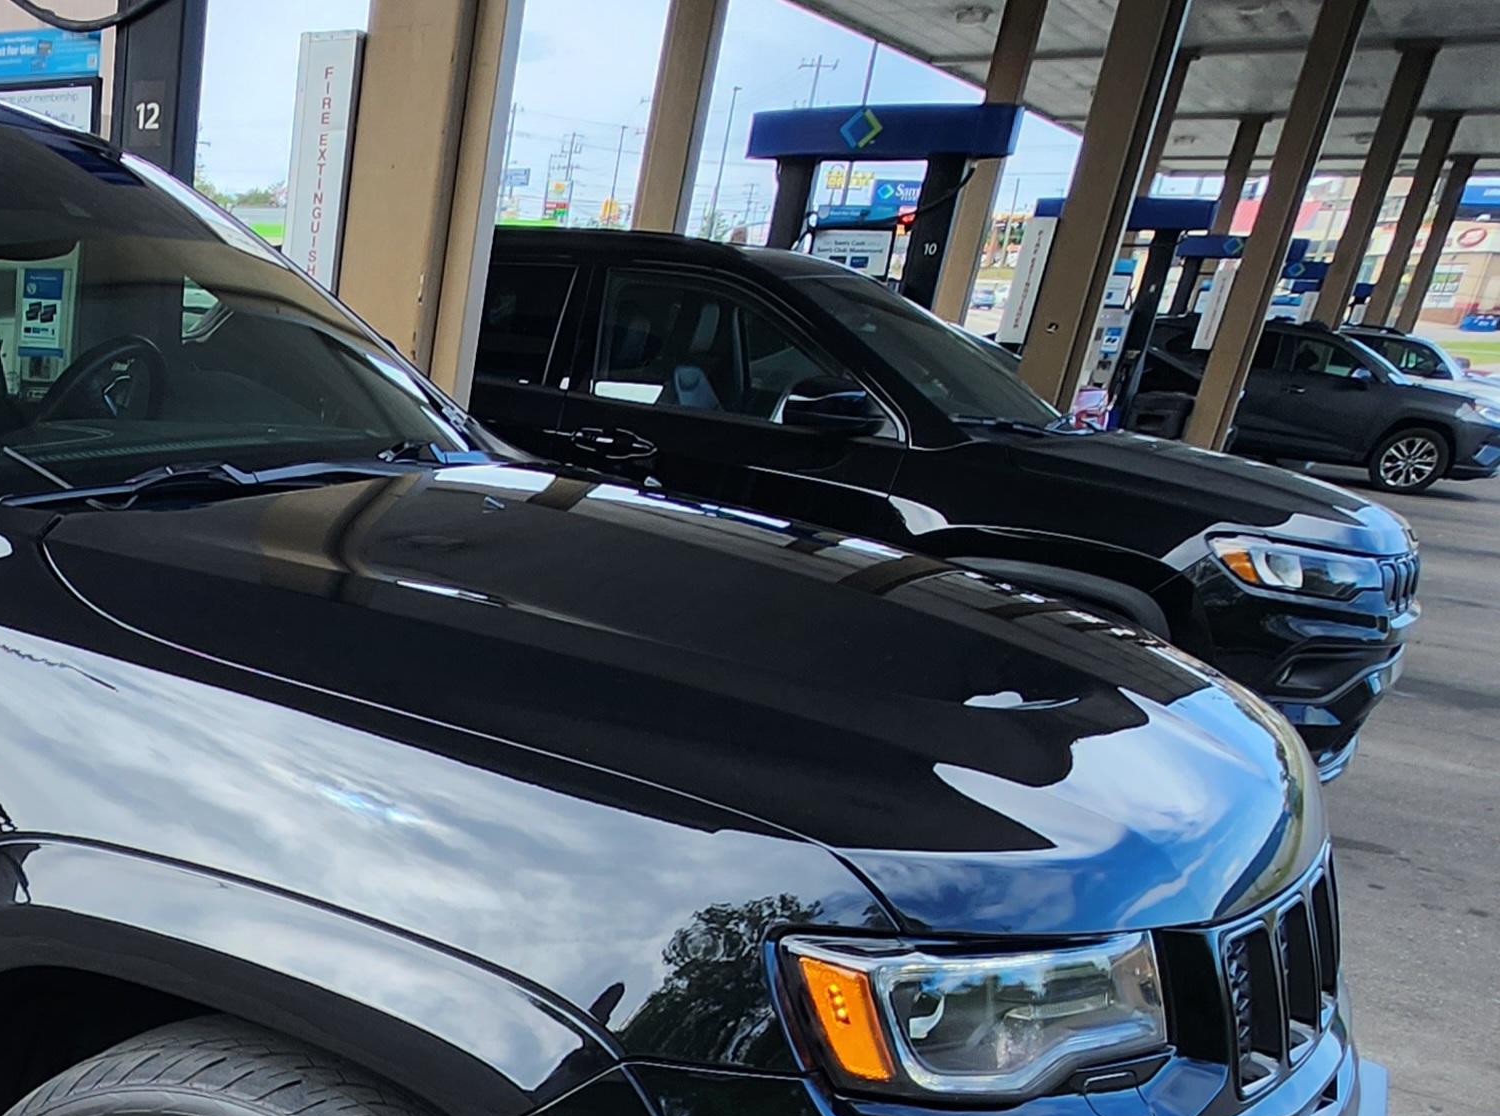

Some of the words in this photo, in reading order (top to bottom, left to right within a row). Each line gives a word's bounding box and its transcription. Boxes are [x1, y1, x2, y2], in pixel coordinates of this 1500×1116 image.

[321, 66, 334, 125] FIRE
[136, 102, 160, 129] 12
[923, 243, 938, 255] 10
